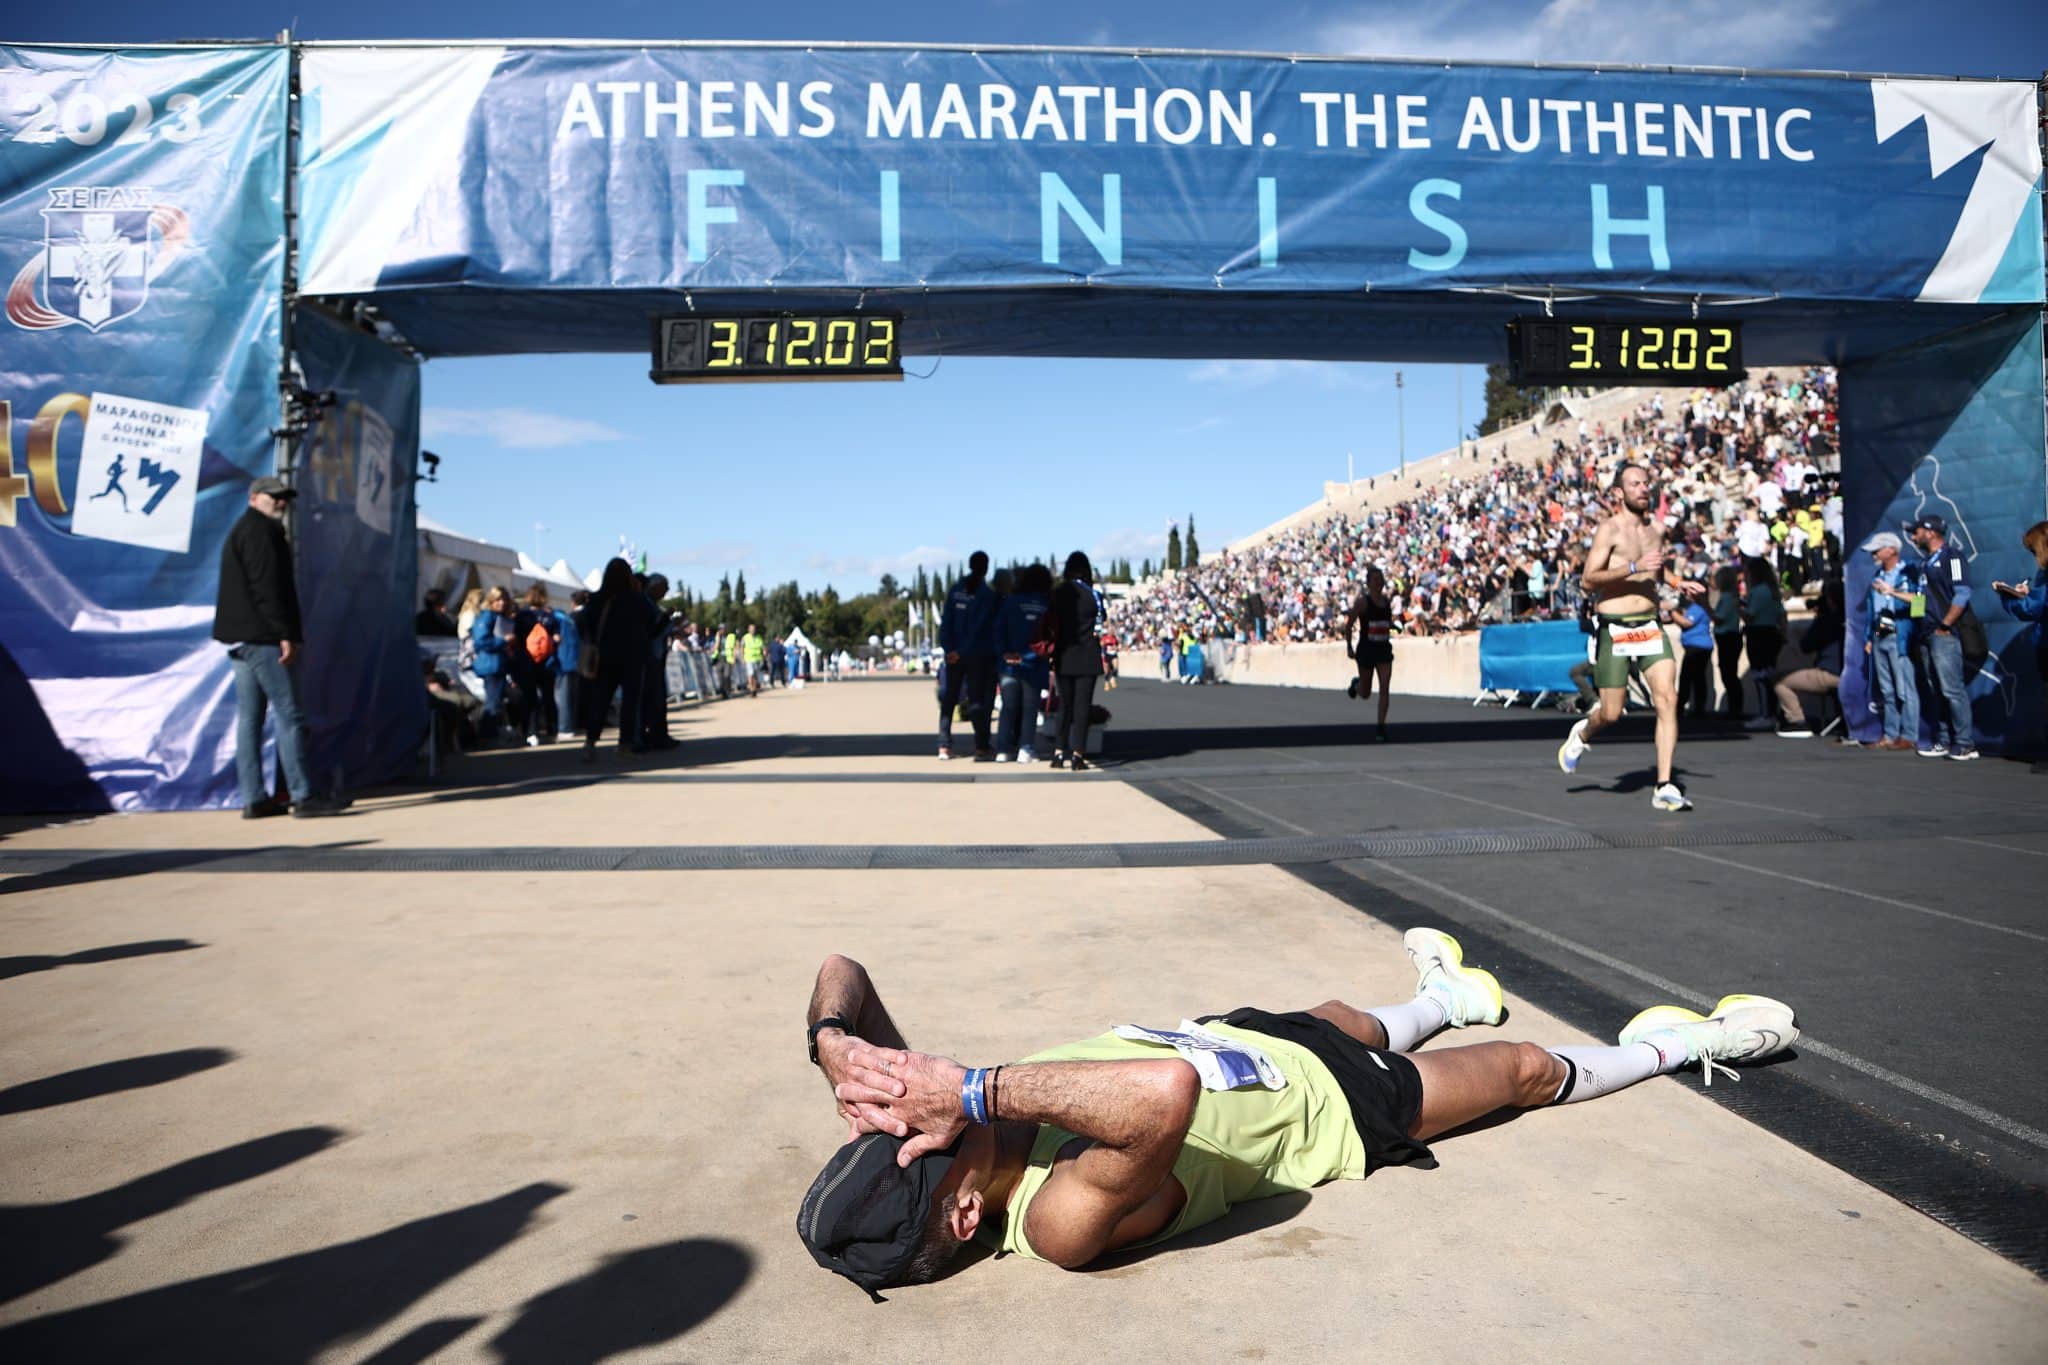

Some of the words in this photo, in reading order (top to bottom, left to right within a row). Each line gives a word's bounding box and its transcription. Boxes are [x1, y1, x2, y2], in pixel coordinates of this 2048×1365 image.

[11, 93, 201, 146] 2023
[556, 81, 836, 139] ATHENS
[866, 82, 1277, 147] MARATHON.
[1300, 92, 1431, 149] THE
[1457, 97, 1815, 162] AUTHENTIC
[687, 169, 1672, 272] FINISH
[1569, 327, 1732, 370] 3.12.02
